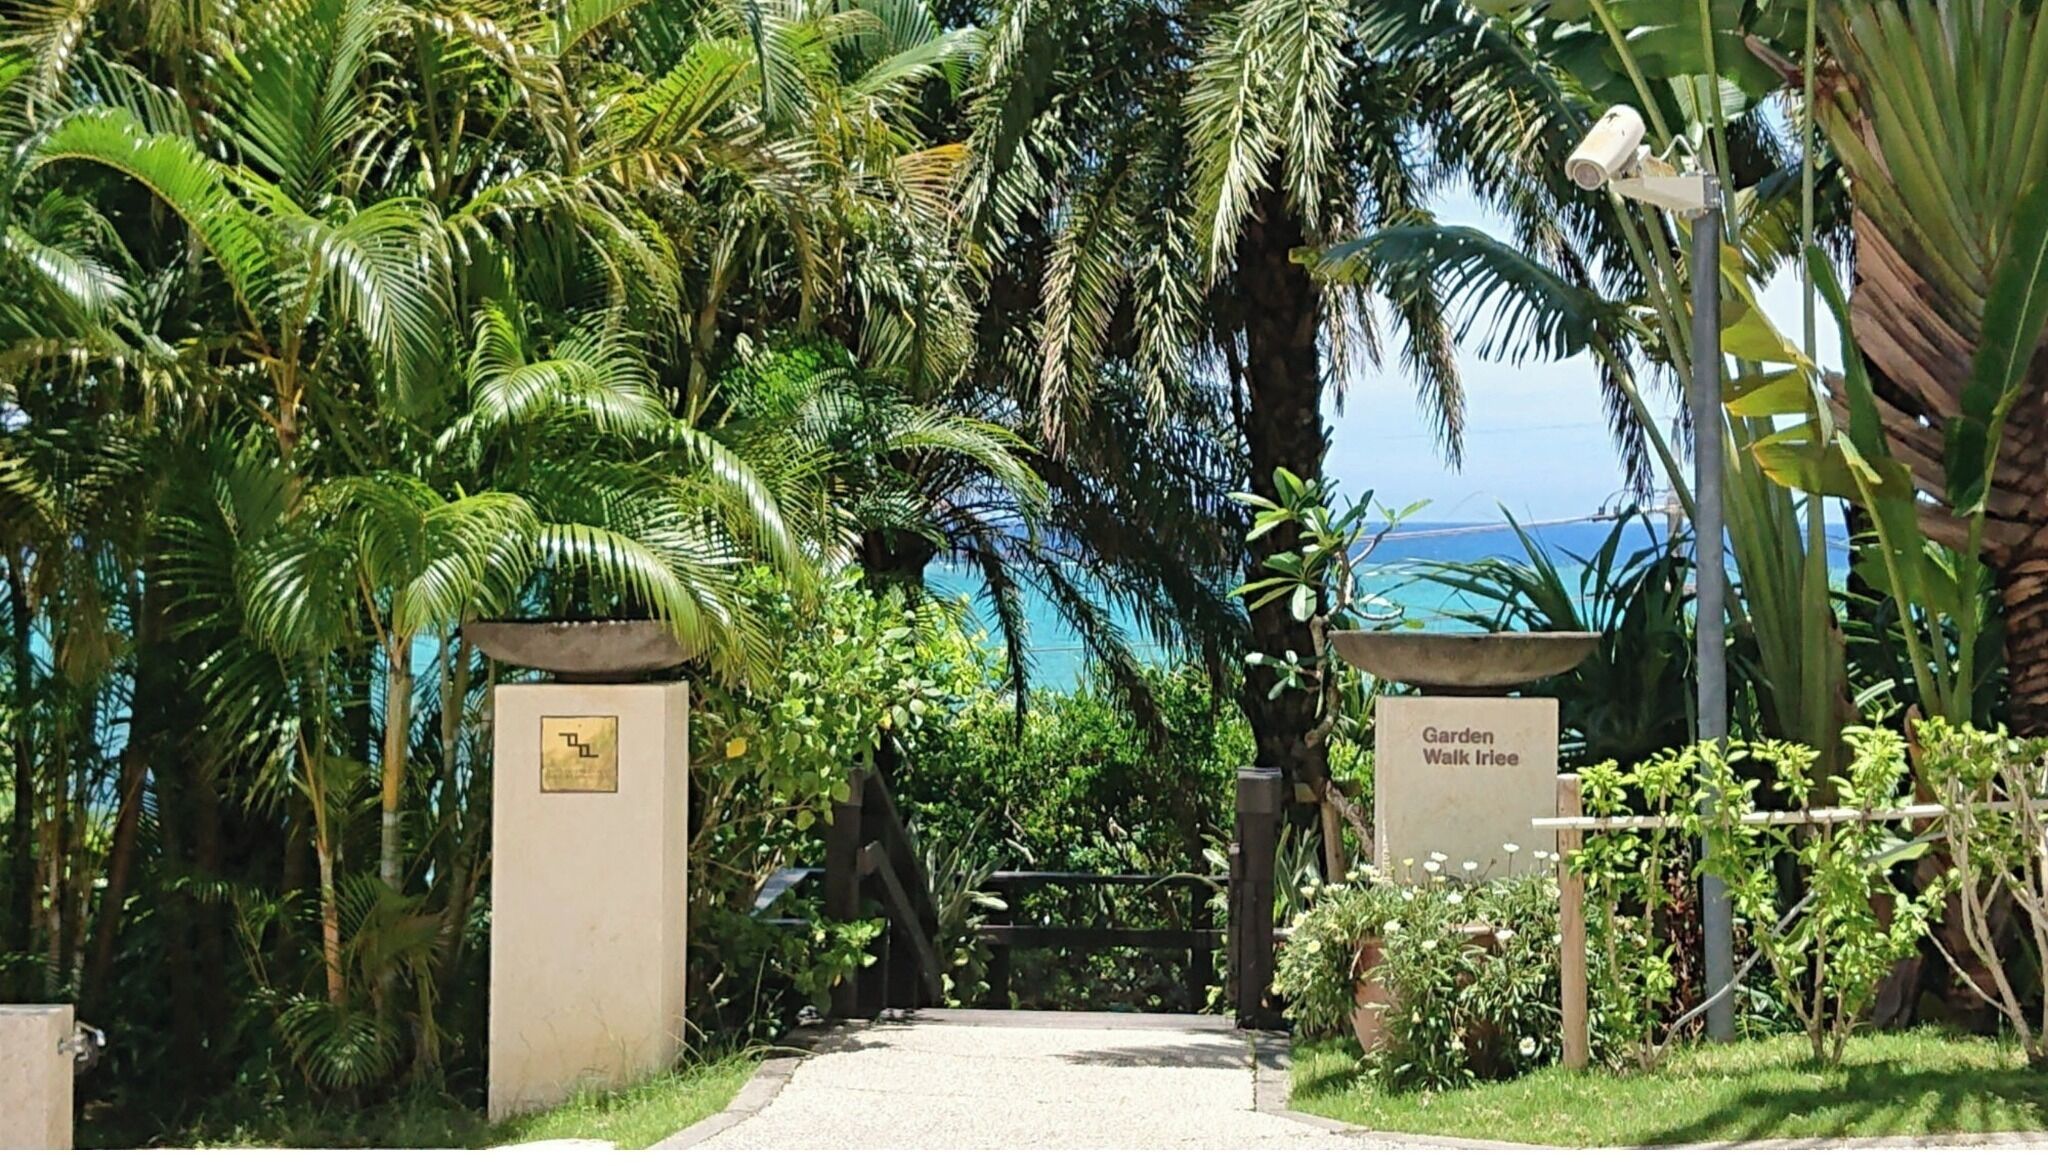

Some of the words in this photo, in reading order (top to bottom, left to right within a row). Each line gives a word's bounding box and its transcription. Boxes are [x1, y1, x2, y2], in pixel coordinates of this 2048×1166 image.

[1422, 726, 1494, 744] Garden
[1422, 748, 1470, 766] Walk
[1475, 749, 1519, 766] Iriee
